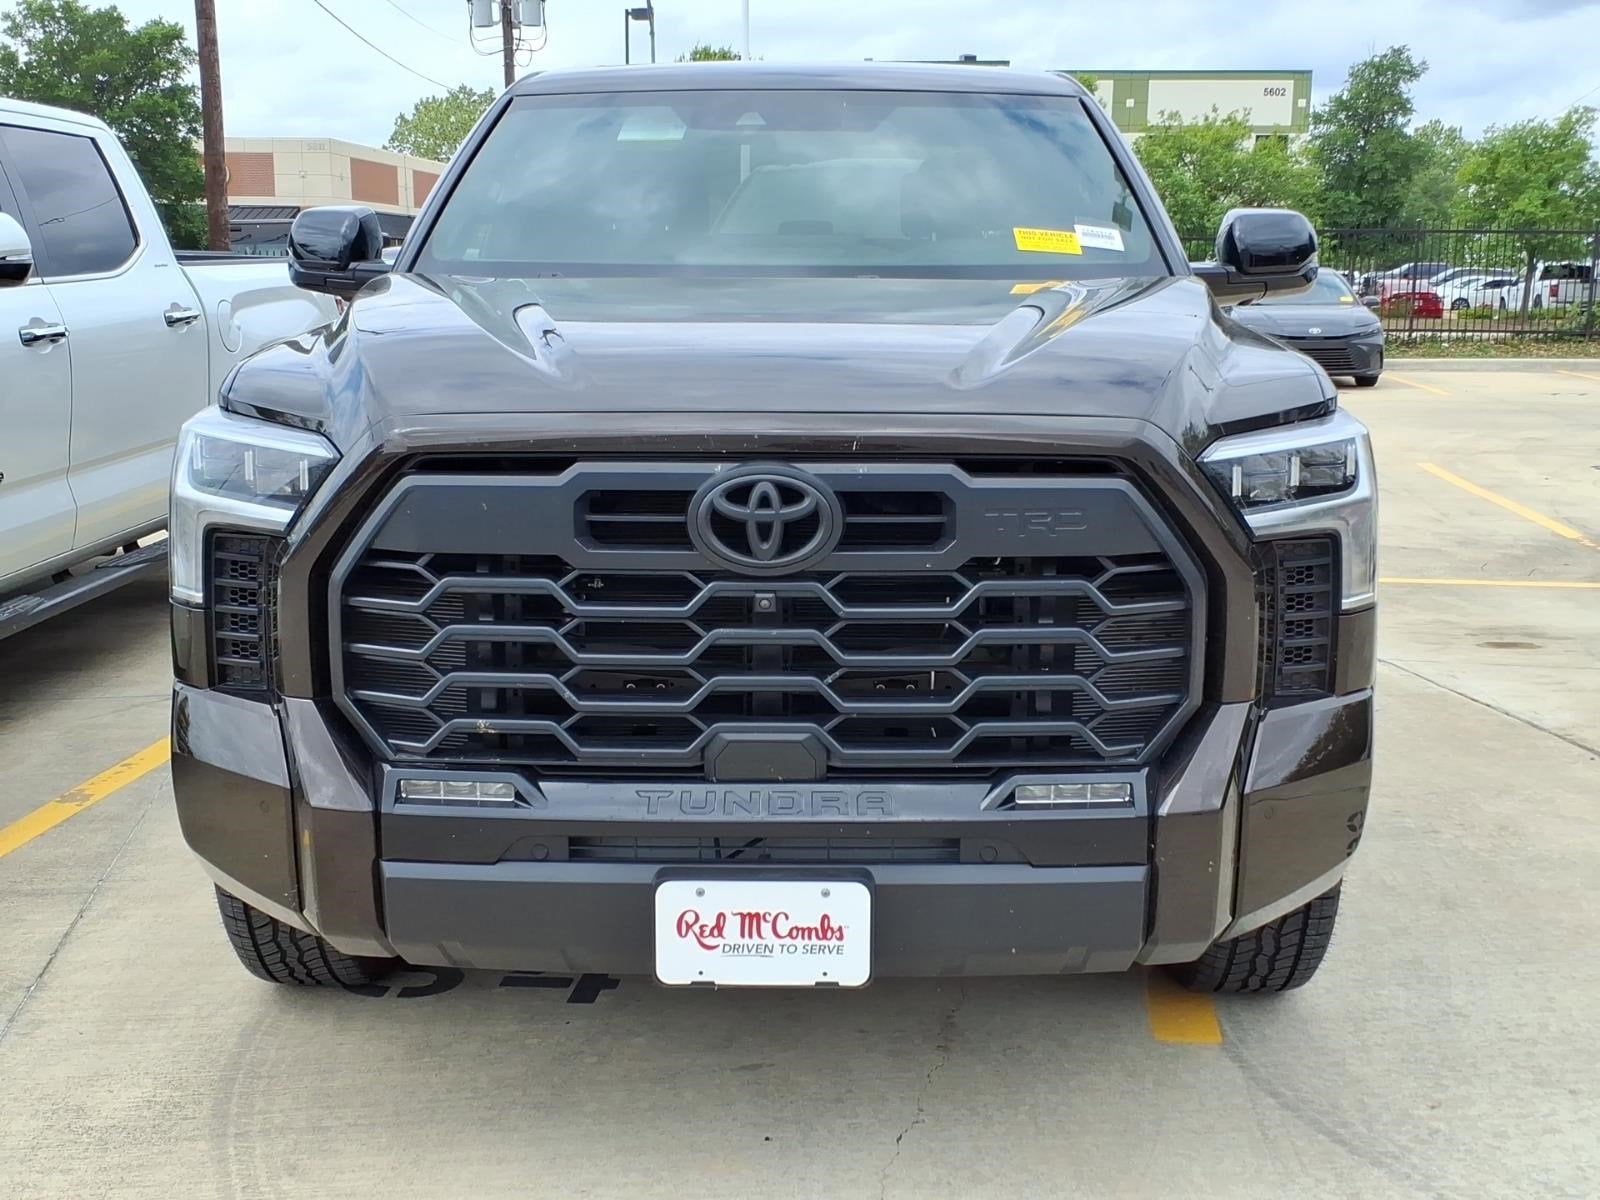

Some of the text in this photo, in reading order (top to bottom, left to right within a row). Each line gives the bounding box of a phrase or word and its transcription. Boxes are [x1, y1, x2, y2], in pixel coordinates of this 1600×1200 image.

[1263, 87, 1287, 97] 5602
[1038, 231, 1073, 239] VEHICLE
[984, 508, 1088, 538] TRD
[635, 789, 895, 816] TUNDRA
[676, 908, 727, 951] Red
[721, 943, 845, 956] DRIVEN TO SERVE
